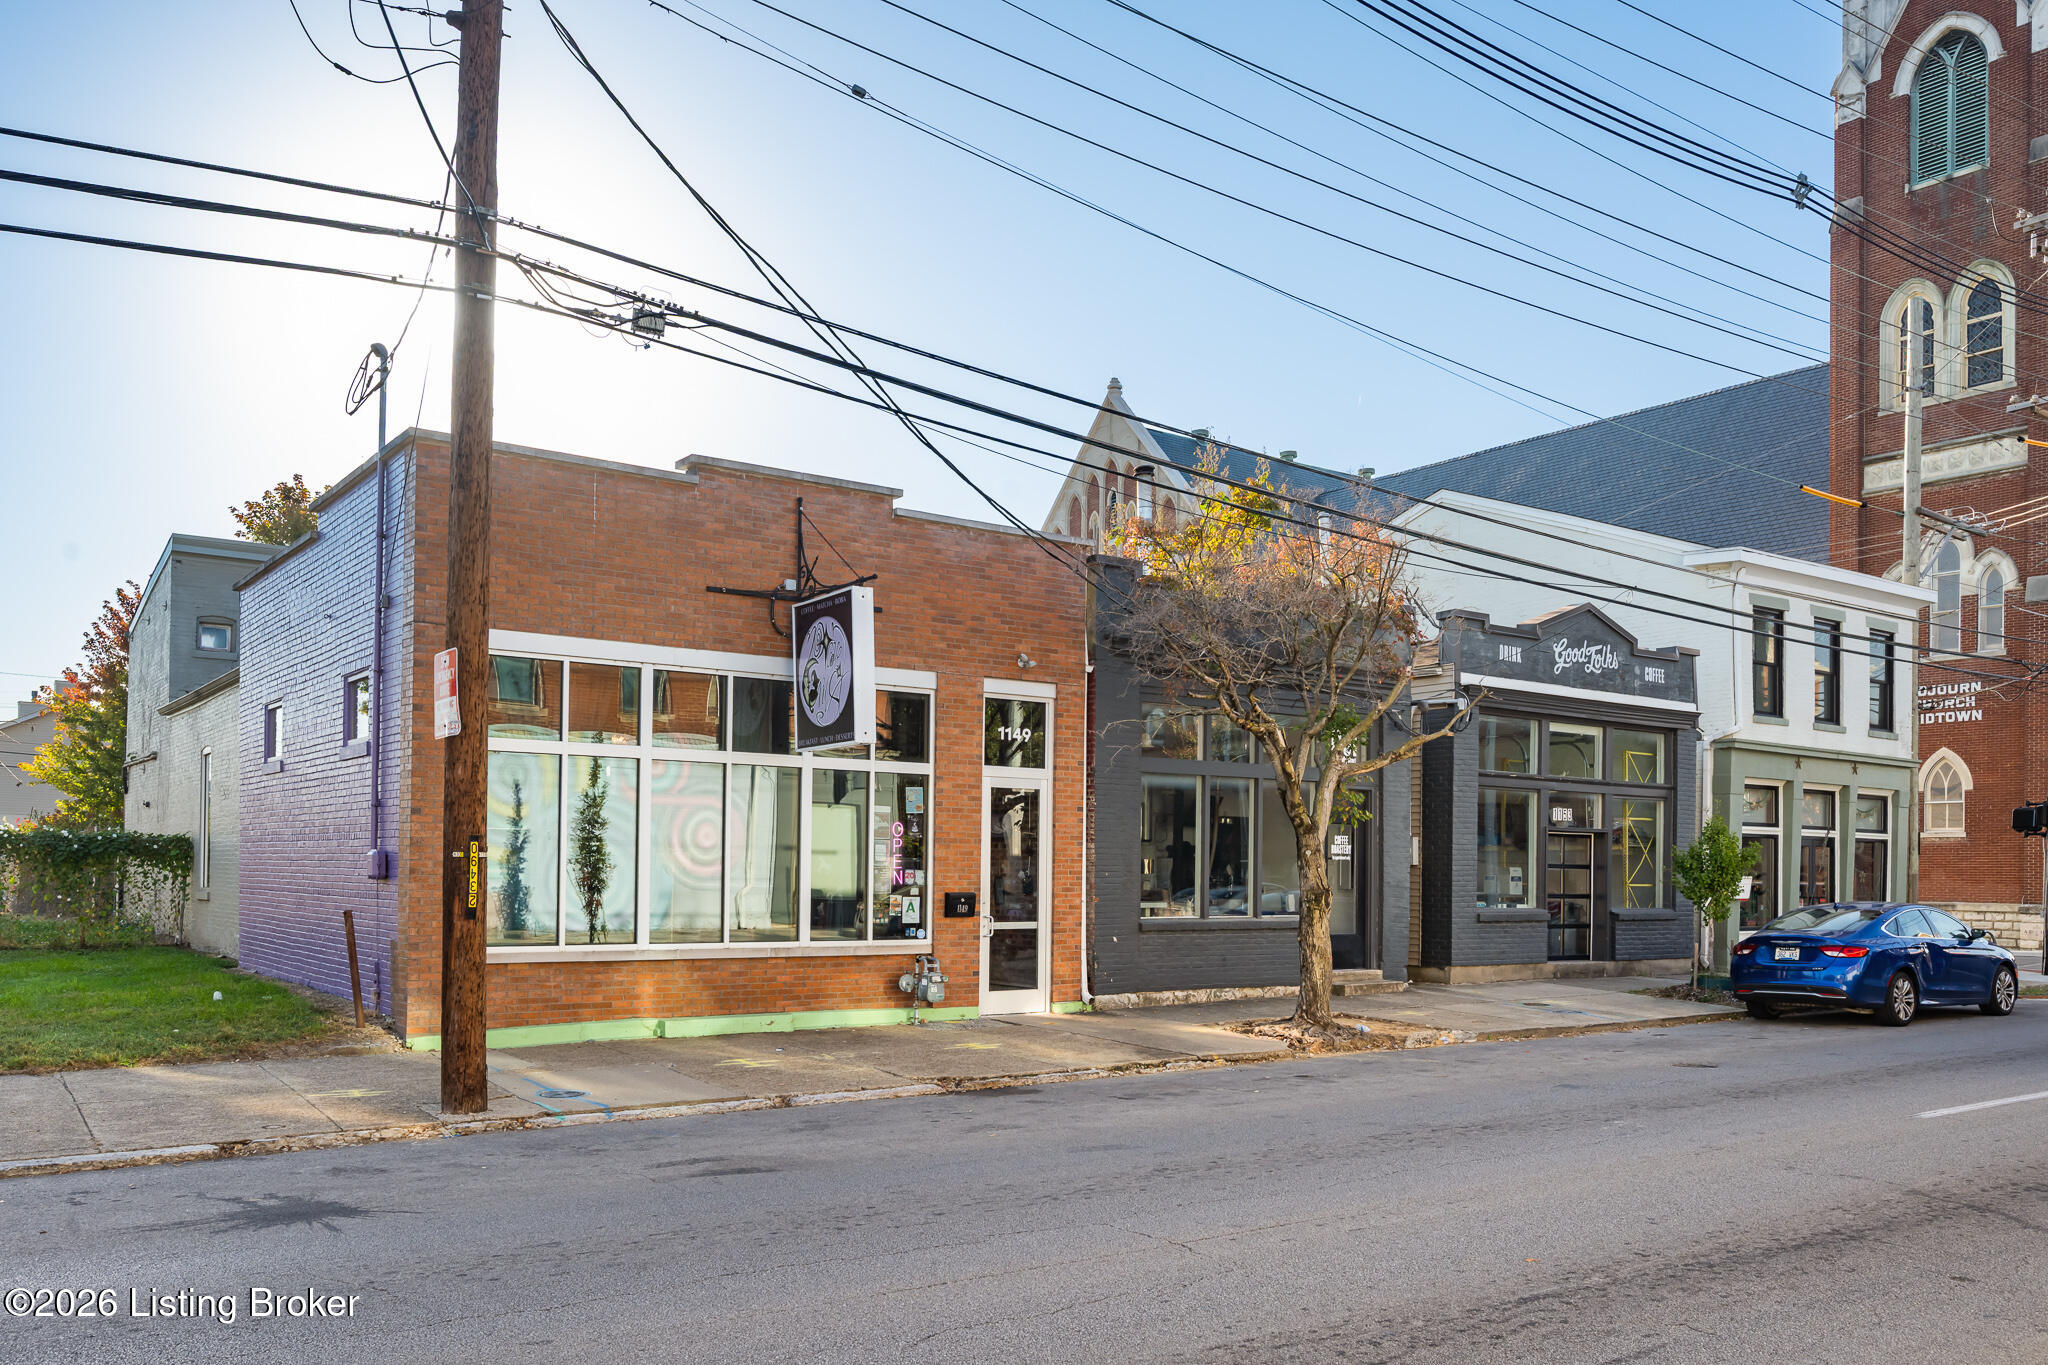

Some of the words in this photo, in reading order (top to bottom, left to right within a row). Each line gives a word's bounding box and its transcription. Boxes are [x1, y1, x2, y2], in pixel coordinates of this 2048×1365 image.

[1499, 644, 1522, 664] DRINK
[1644, 666, 1665, 684] COFFEE
[1917, 681, 1982, 697] OJOURN
[1920, 709, 1983, 725] IDTOWN
[997, 726, 1032, 743] 1149
[892, 821, 905, 885] OPEN
[906, 901, 915, 912] A
